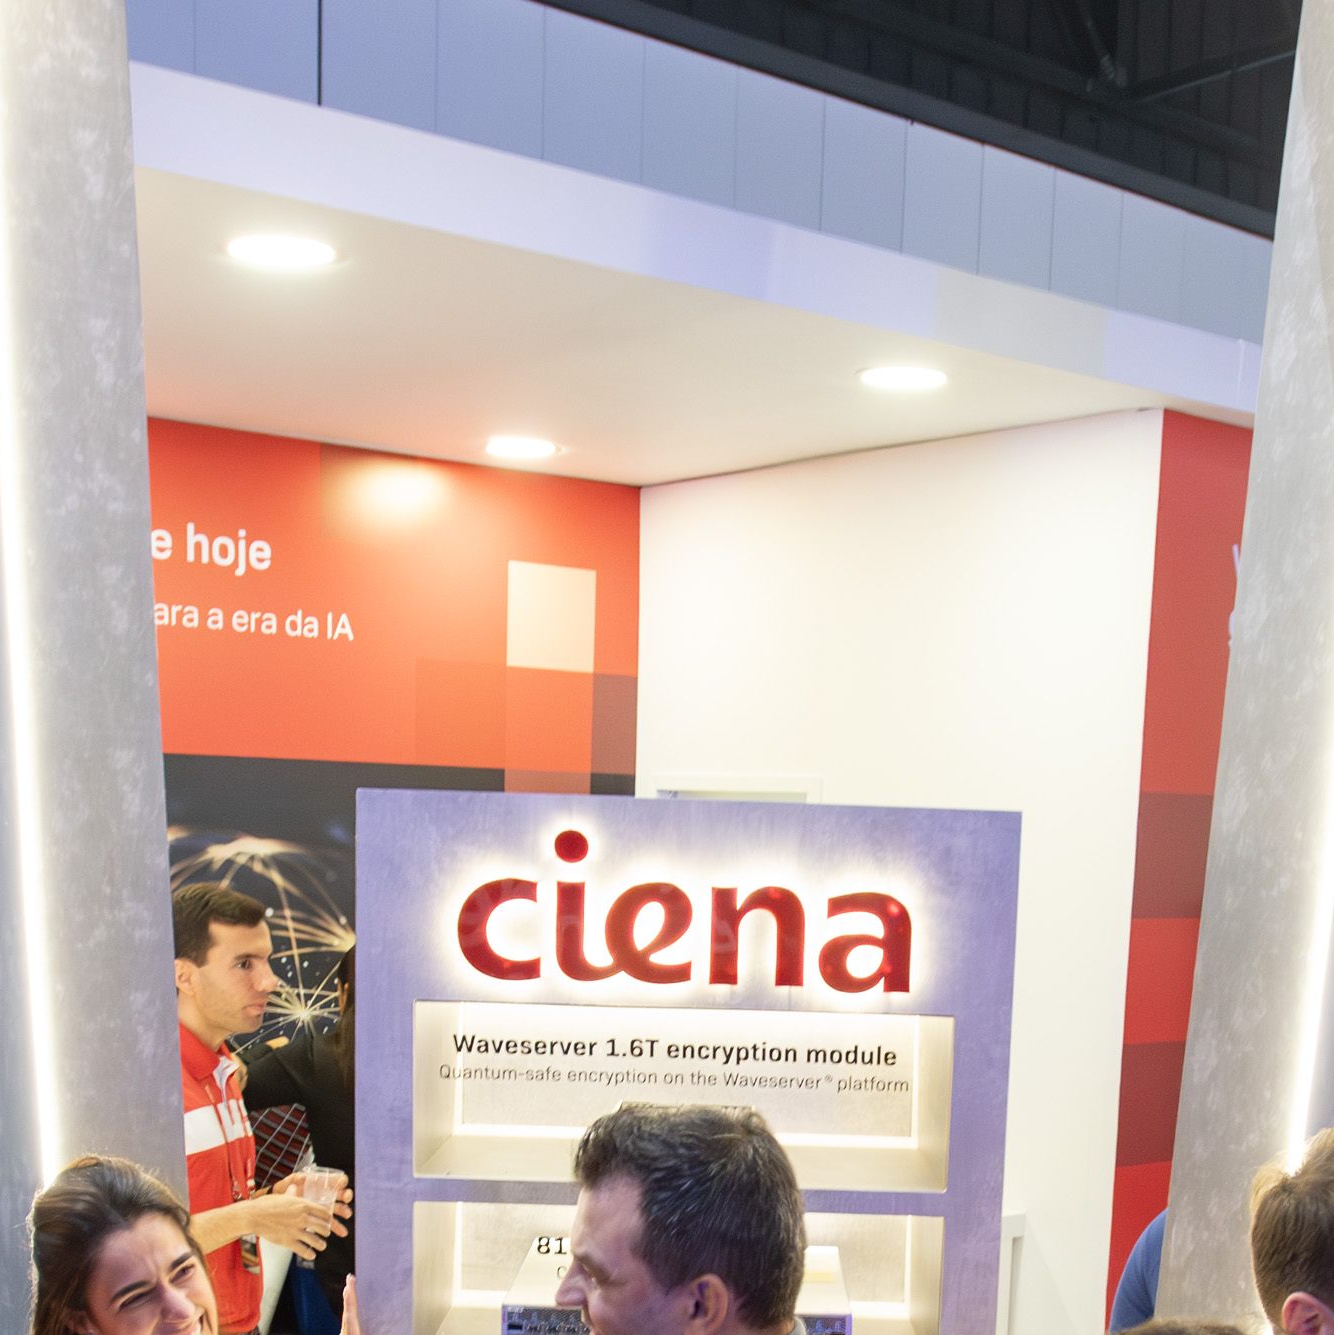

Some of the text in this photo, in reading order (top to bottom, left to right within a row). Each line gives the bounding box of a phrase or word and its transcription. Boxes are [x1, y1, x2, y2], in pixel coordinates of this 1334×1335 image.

[186, 522, 272, 577] hoje
[154, 602, 199, 628] ara
[207, 607, 224, 630] a
[231, 609, 277, 635] era
[285, 609, 319, 638] da
[327, 611, 355, 641] IA
[456, 830, 915, 995] ciena
[453, 1034, 898, 1066] Waveserver 1.6T encryption module
[439, 1064, 561, 1082] Quantum-safe
[567, 1068, 658, 1086] encryption
[663, 1071, 684, 1086] on
[690, 1070, 717, 1086] the
[837, 1075, 910, 1093] platform
[536, 1237, 566, 1255] 81
